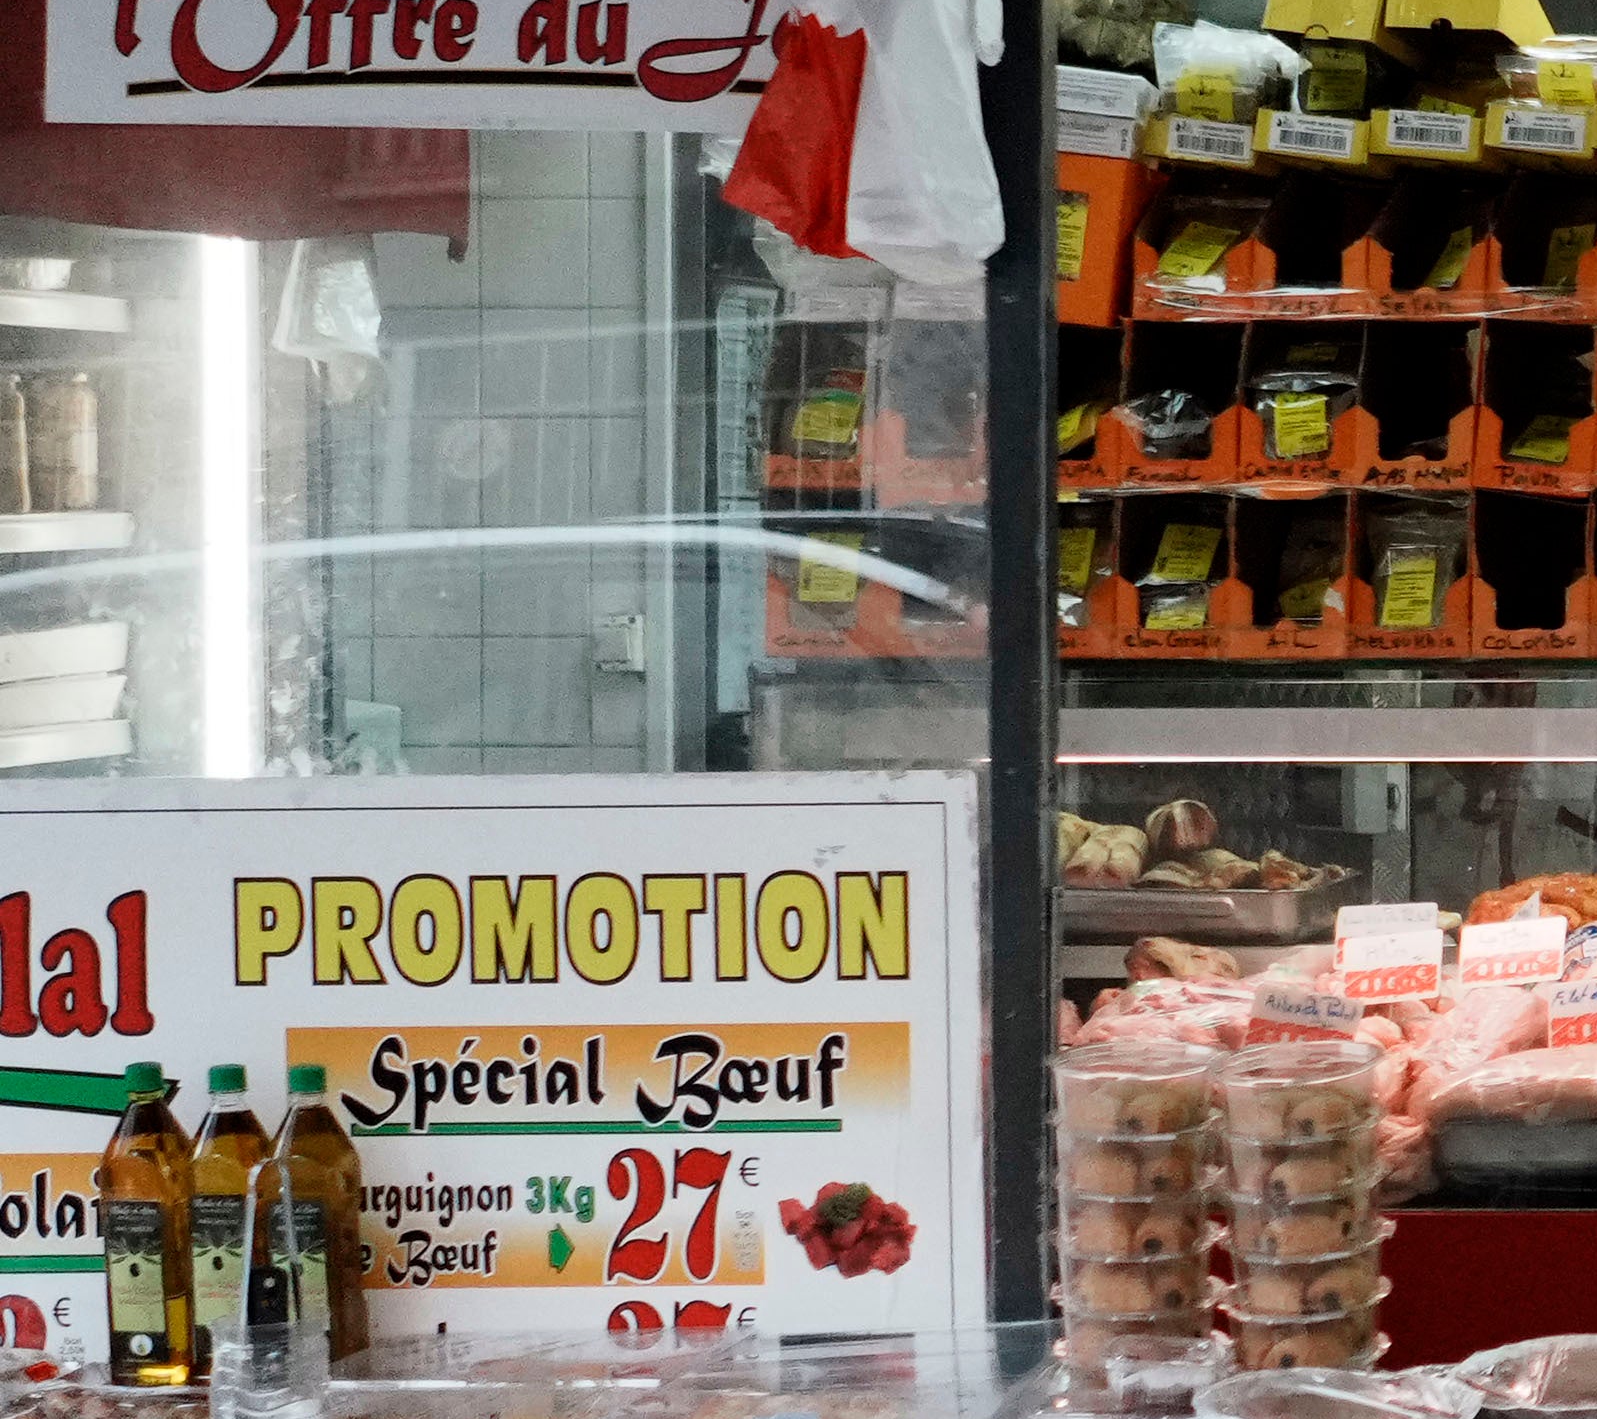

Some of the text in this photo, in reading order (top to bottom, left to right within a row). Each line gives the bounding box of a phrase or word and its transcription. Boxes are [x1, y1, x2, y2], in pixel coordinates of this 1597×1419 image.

[233, 869, 909, 986] PROMOTION
[340, 1035, 605, 1134] Spécial
[525, 1175, 596, 1223] 3Kg
